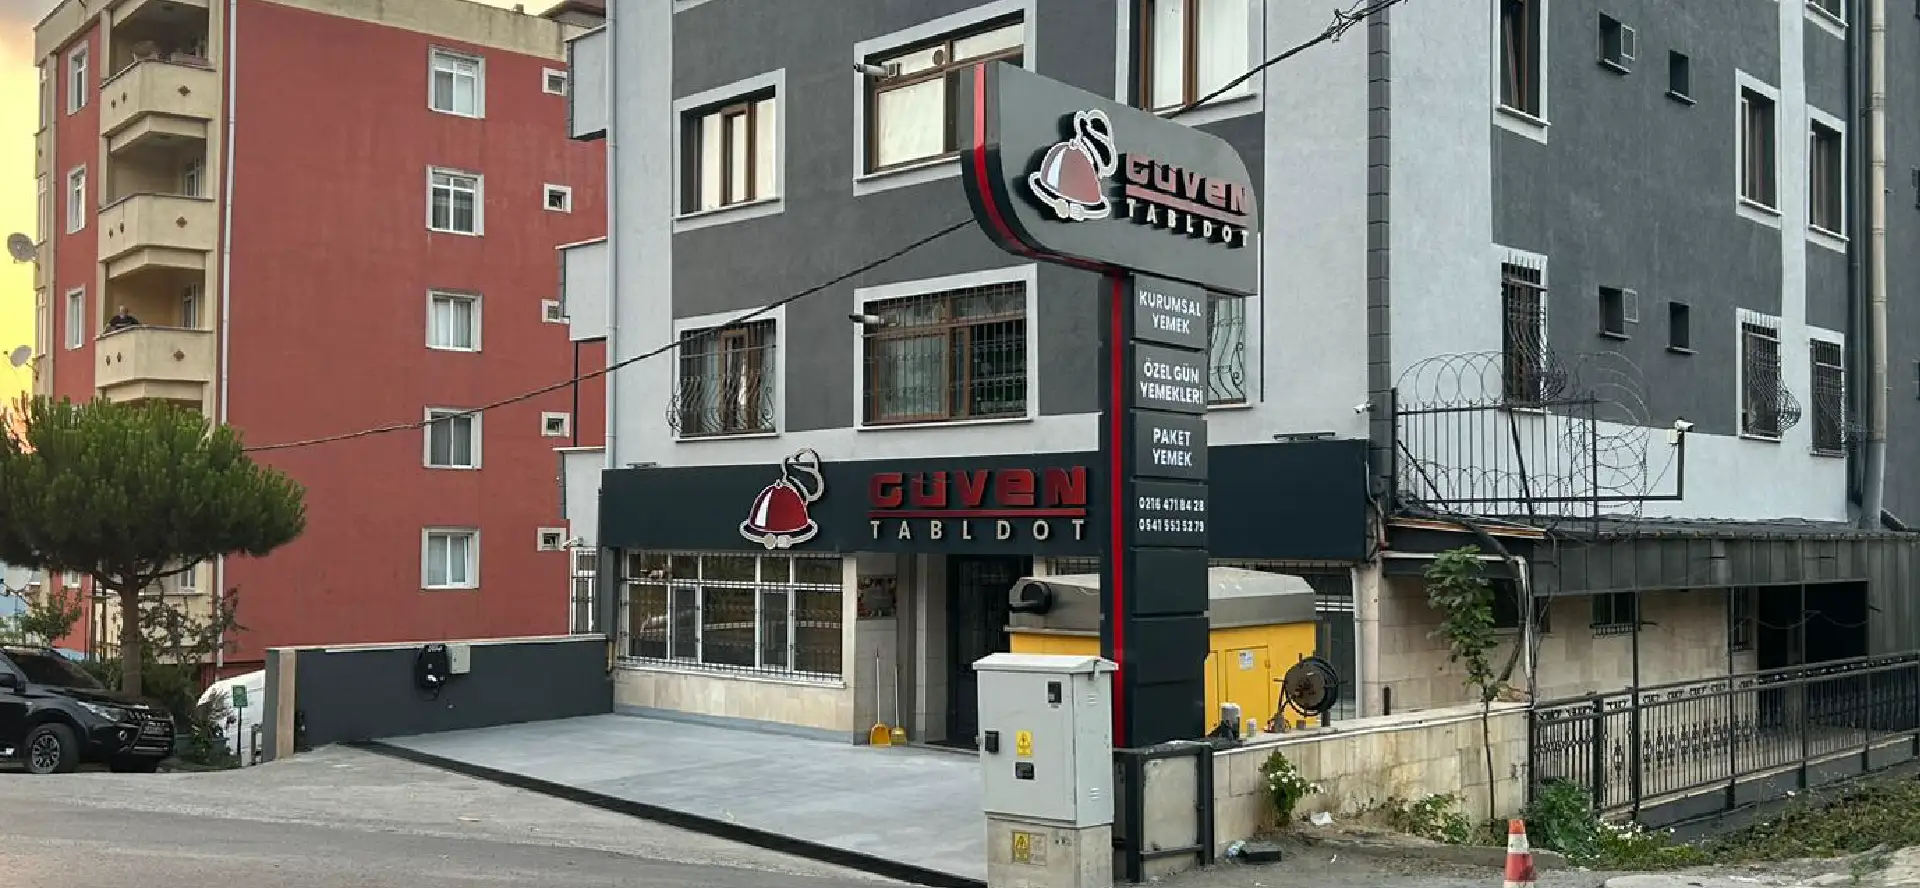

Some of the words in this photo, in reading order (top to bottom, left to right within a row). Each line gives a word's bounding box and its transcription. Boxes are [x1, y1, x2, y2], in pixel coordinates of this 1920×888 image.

[1126, 198, 1249, 247] TABLDOT
[1139, 289, 1201, 317] KURUMSAL
[1152, 312, 1190, 334] YEMEK
[1143, 355, 1172, 381] ÖZEL
[1174, 362, 1200, 384] GÜN
[1140, 380, 1204, 405] YEMEKLERİ
[1153, 427, 1191, 447] PAKET
[1152, 447, 1192, 467] YEMEK
[869, 518, 1085, 541] TABLDOT
[1138, 518, 1162, 532] 0541
